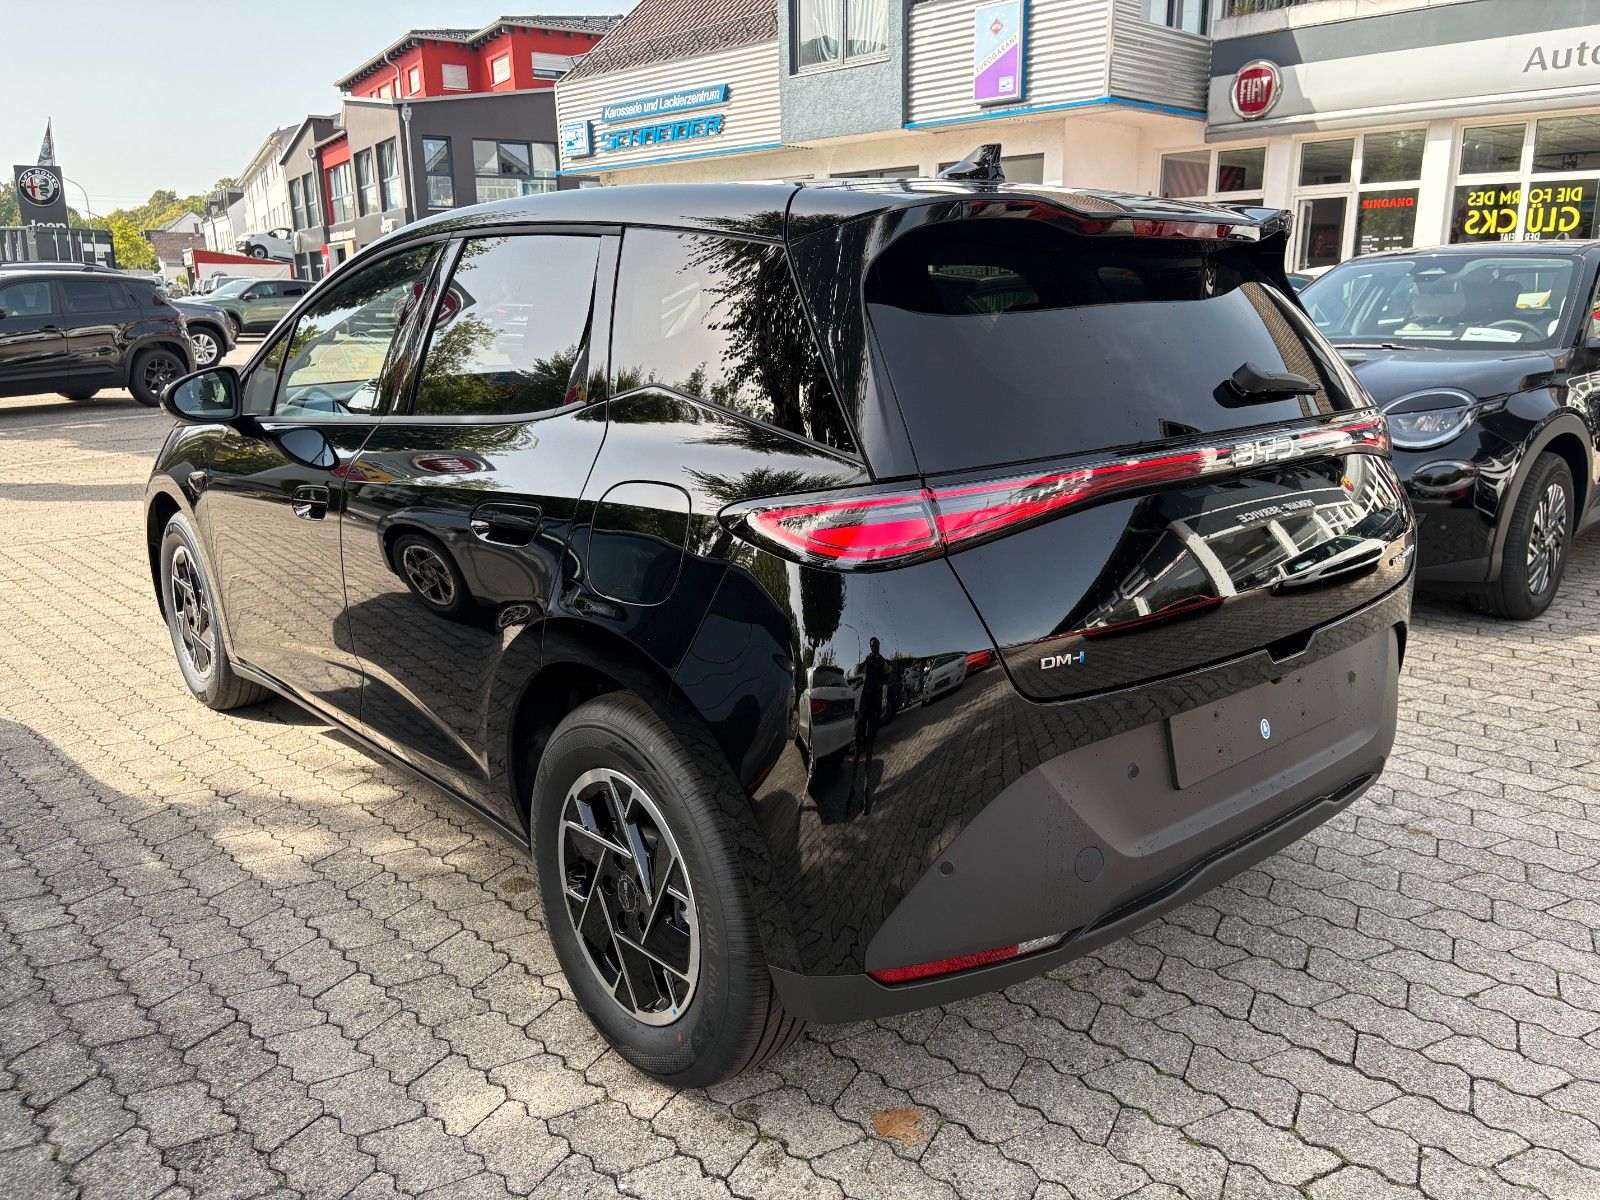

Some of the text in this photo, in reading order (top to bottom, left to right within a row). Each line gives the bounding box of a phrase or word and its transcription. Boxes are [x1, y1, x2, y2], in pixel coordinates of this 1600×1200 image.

[976, 34, 1017, 73] EUROGARANT
[604, 89, 720, 119] Karosserie und Lackierzentrum
[1240, 75, 1271, 104] FIAT
[601, 115, 722, 151] SCHNEIDER
[20, 170, 58, 189] ALFA ROMEO
[1362, 197, 1414, 209] EINGANG
[1231, 436, 1295, 466] BYD
[1040, 651, 1085, 670] DM-i
